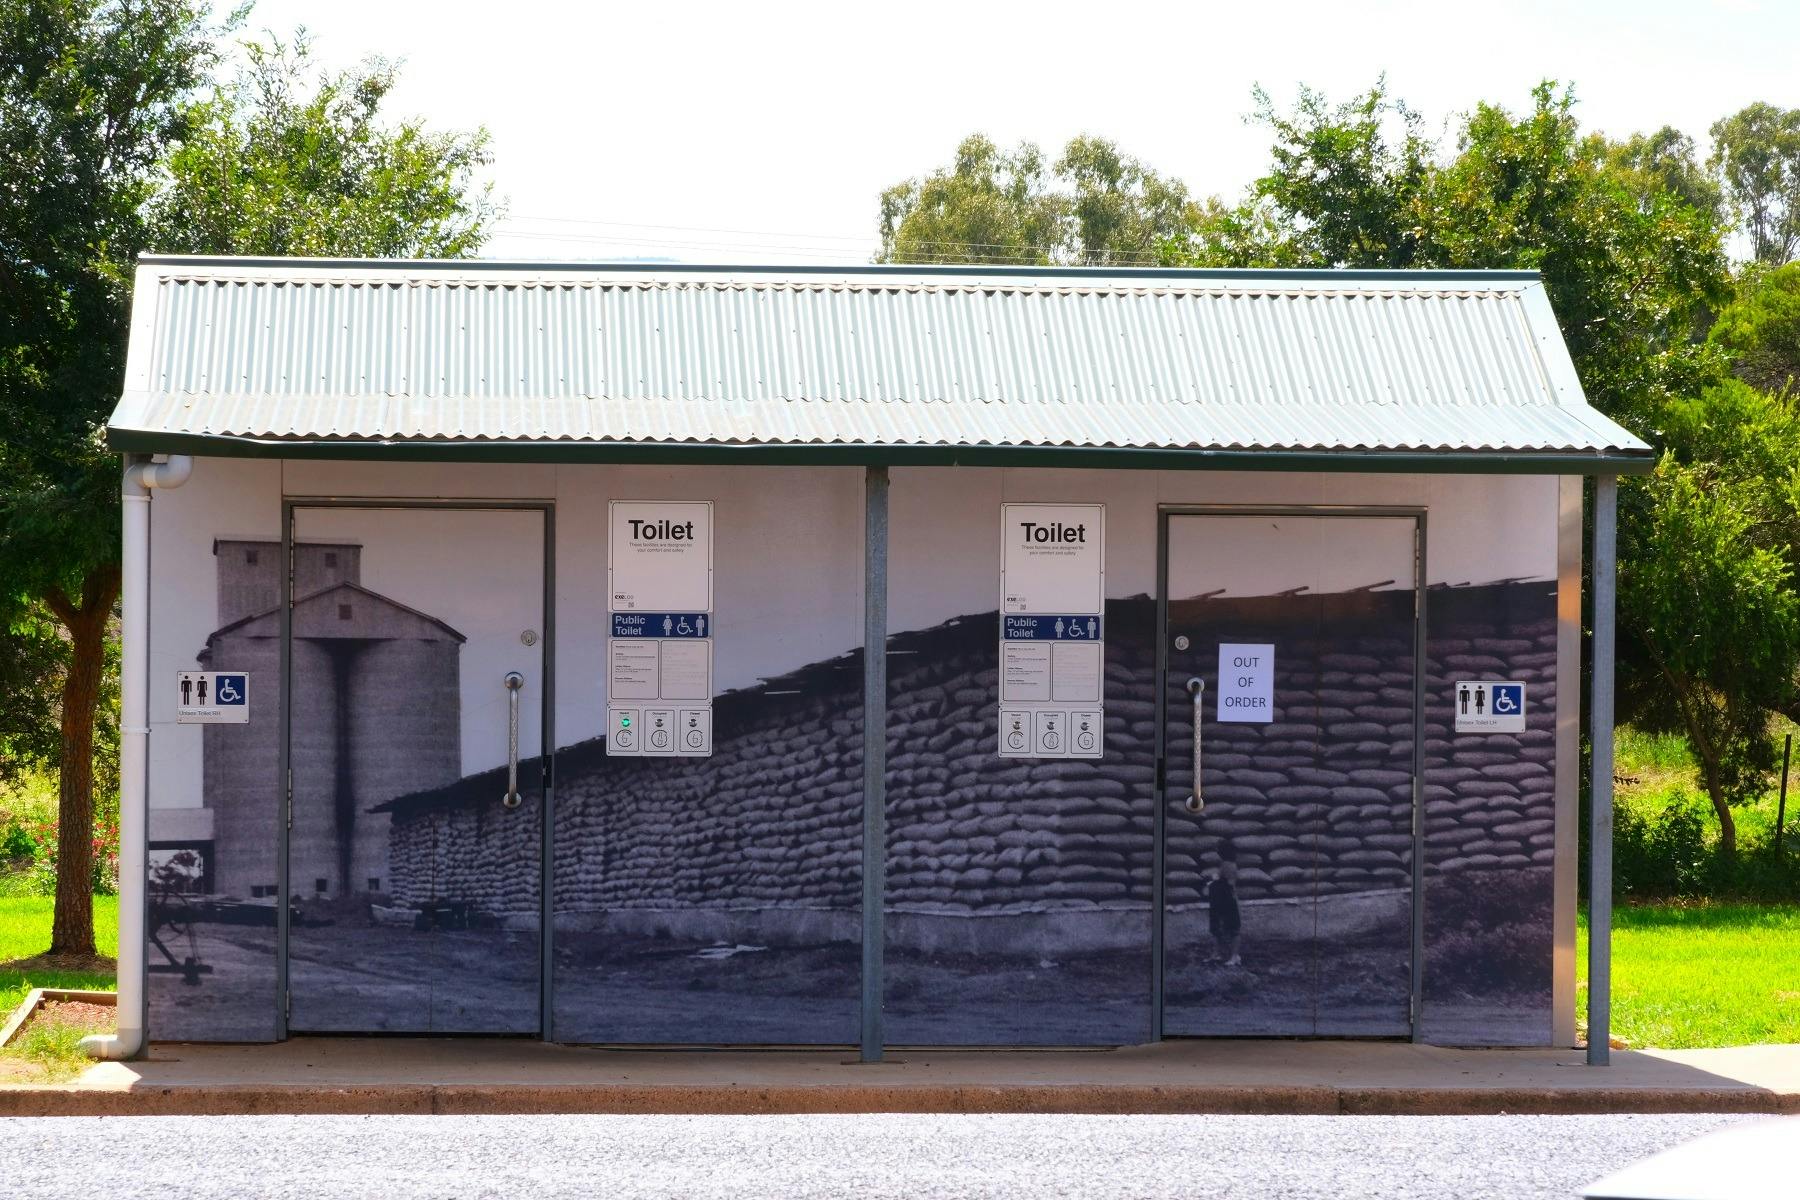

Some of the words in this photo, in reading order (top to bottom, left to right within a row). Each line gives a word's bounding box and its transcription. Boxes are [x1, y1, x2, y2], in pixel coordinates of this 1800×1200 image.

[628, 519, 694, 540] Toilet
[1020, 522, 1086, 543] Toilet
[615, 615, 646, 625] Public
[1007, 618, 1038, 627] Public
[616, 626, 642, 635] Toilet
[1008, 628, 1034, 638] Toilet
[1233, 657, 1260, 668] OUT
[1238, 677, 1254, 688] OF
[1225, 696, 1266, 708] ORDER
